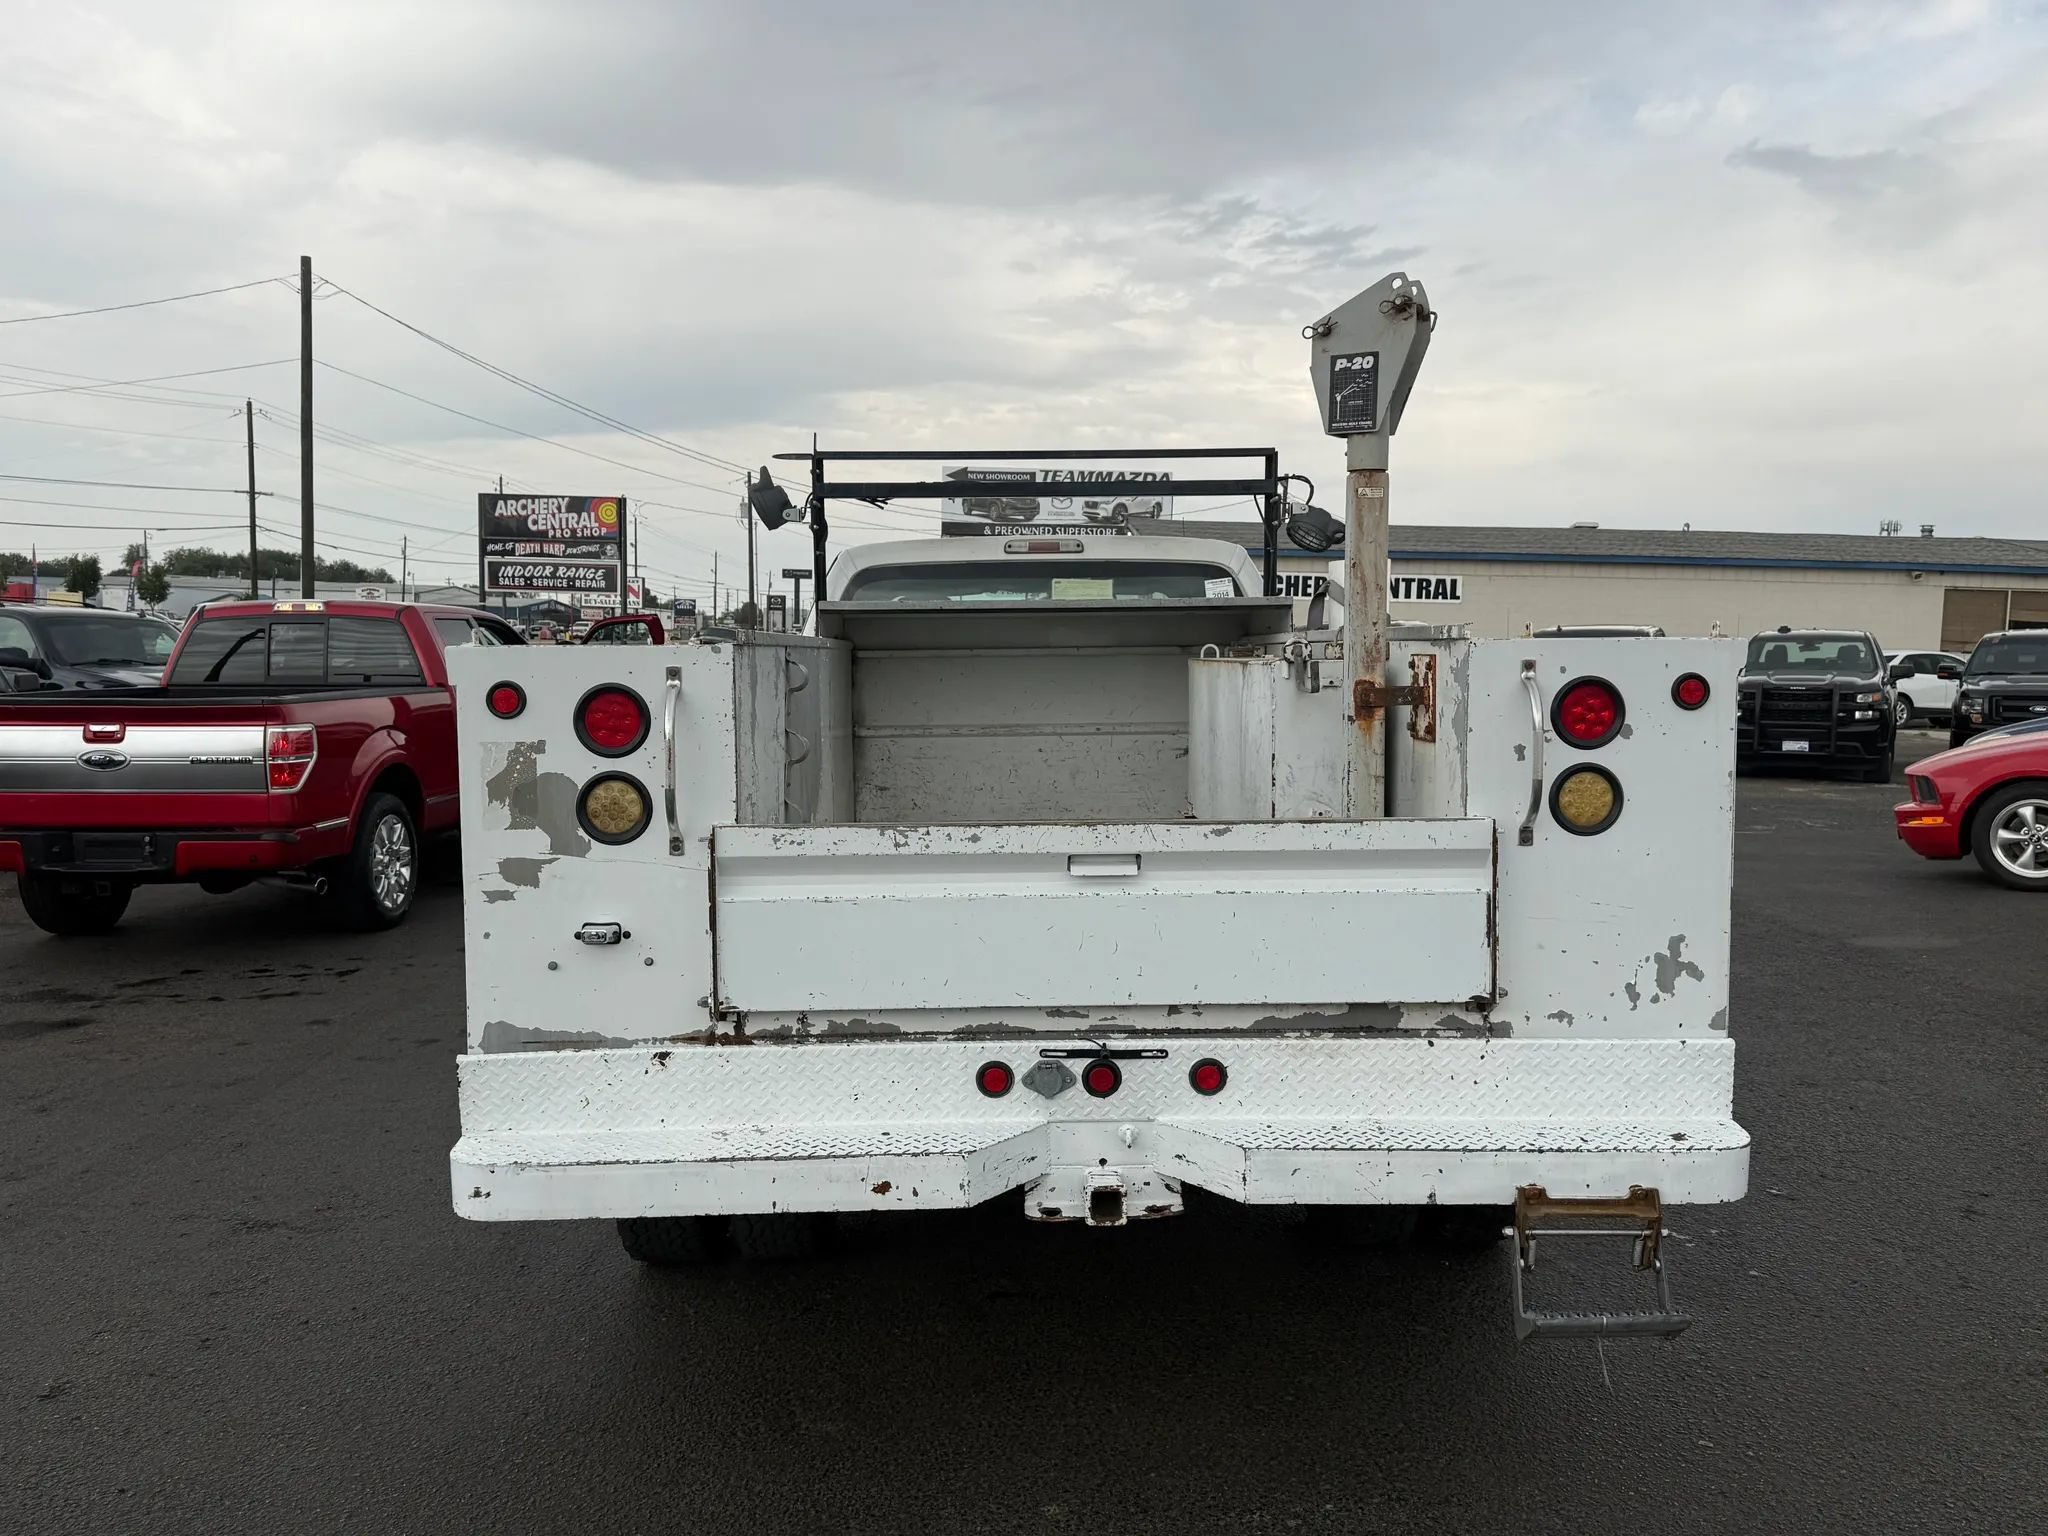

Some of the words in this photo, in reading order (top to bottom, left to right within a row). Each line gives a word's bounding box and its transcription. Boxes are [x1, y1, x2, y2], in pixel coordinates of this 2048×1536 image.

[1334, 356, 1374, 371] P-20
[495, 497, 569, 517] ARCHERY
[527, 512, 599, 531] CENTRAL
[548, 529, 571, 538] PRO
[576, 528, 607, 537] SHOP
[983, 526, 992, 535] &
[995, 526, 1053, 536] PREOWNED
[1056, 527, 1118, 536] SUPERSTORE
[515, 542, 542, 556] DEATH
[543, 542, 565, 556] HARP
[499, 565, 554, 578] INDOOR
[556, 566, 606, 580] RANGE
[499, 578, 525, 586] SALES
[532, 579, 568, 587] SERVICE
[575, 579, 606, 588] REPAIR
[1390, 577, 1461, 601] NTRAL
[190, 756, 252, 765] PLATINUM
